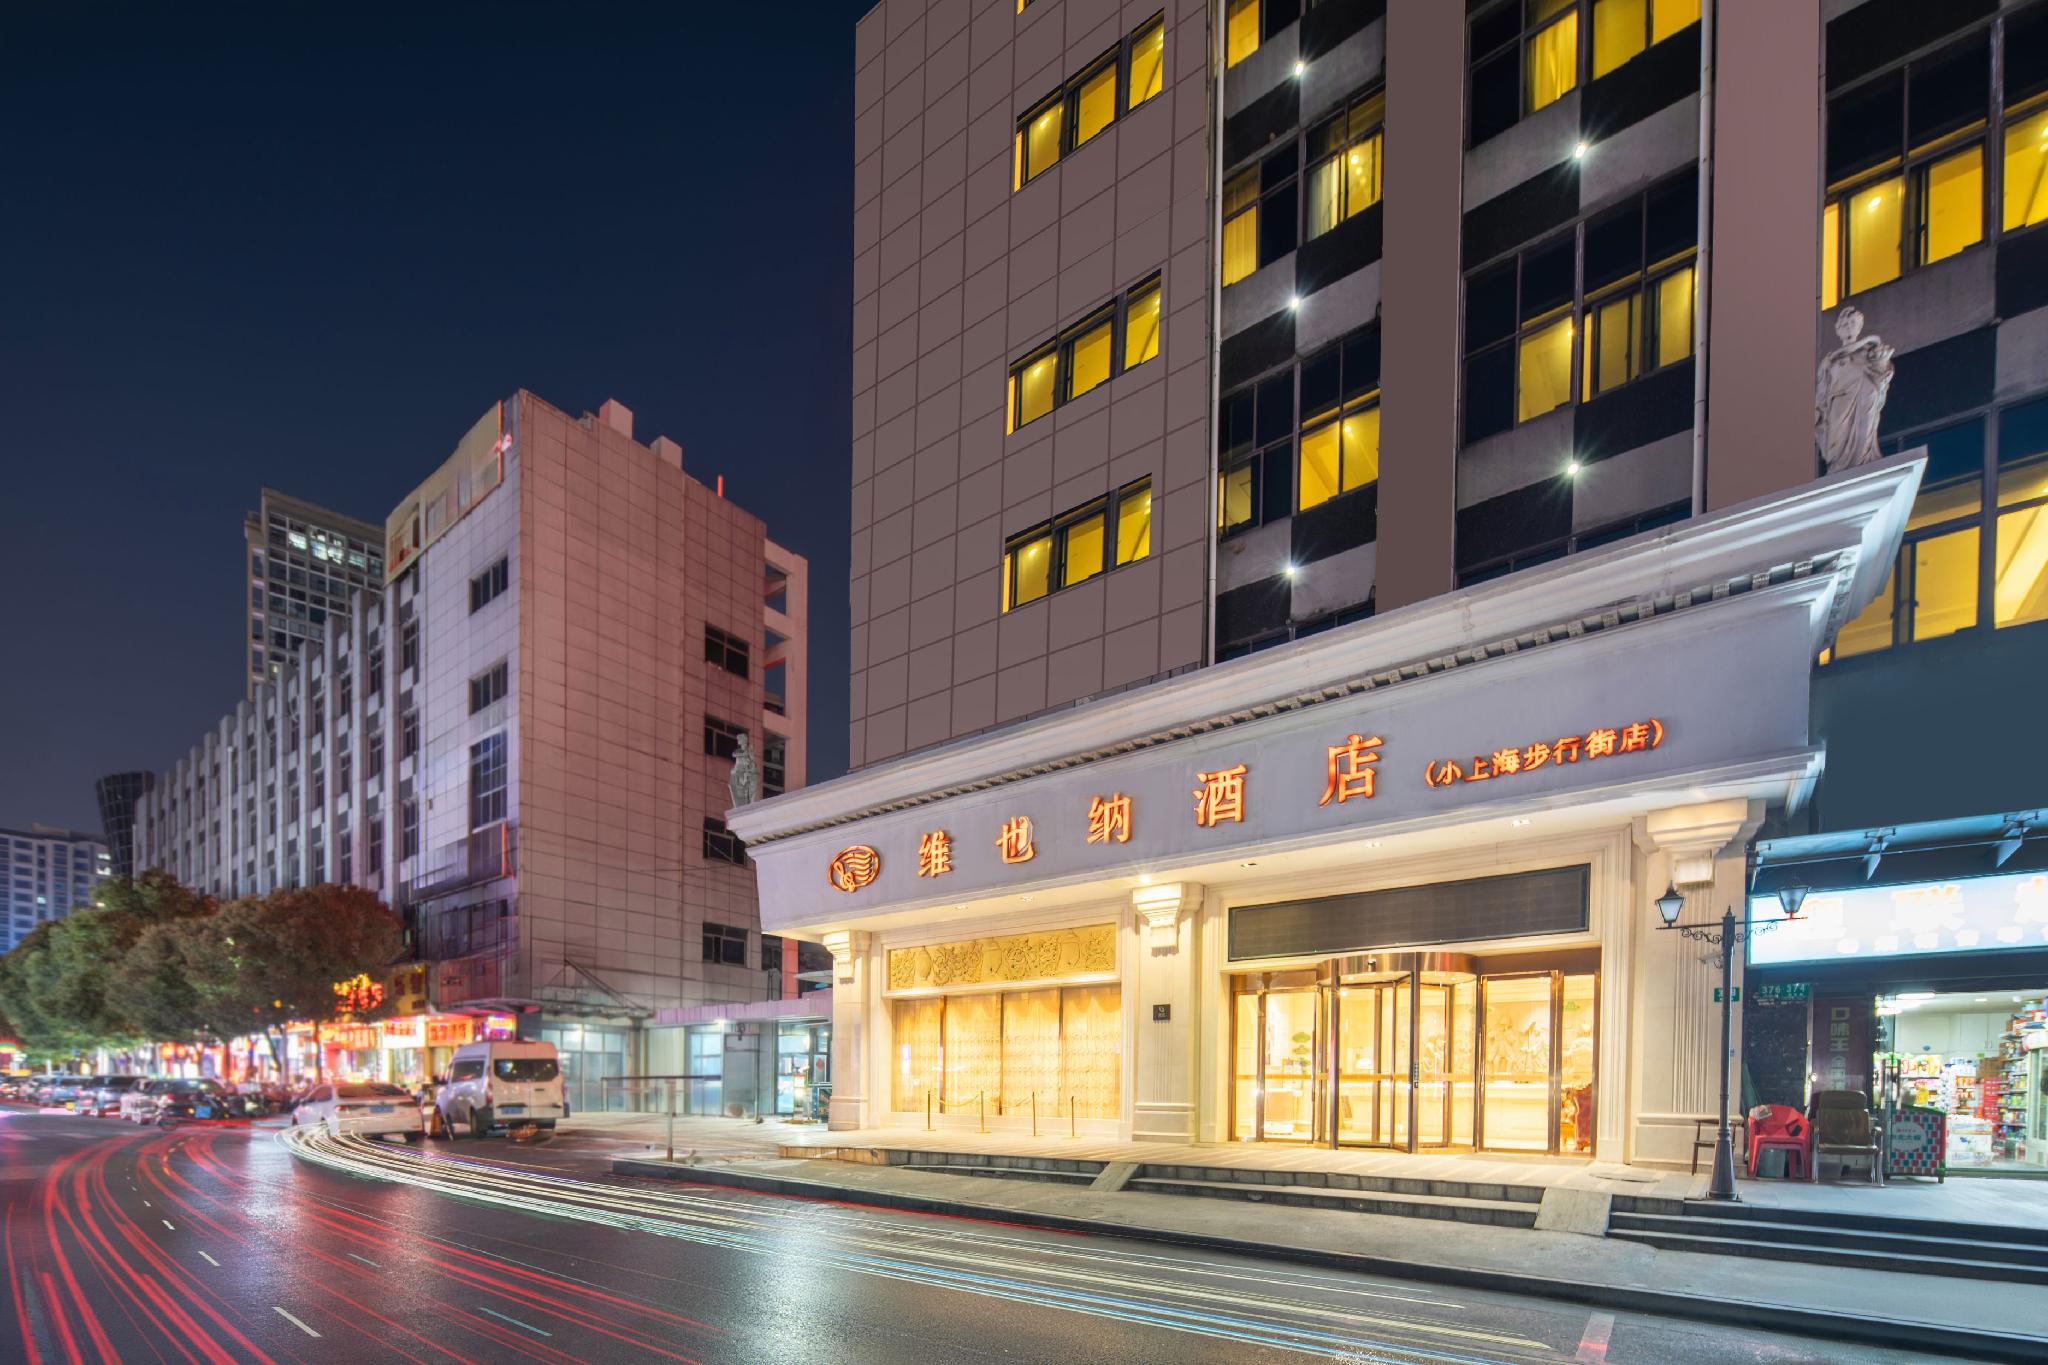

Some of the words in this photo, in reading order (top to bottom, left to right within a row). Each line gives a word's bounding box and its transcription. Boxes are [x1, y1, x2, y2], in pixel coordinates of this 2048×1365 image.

[917, 733, 1384, 878] 维也纳酒店
[1424, 718, 1665, 787] （小上海步行街店）
